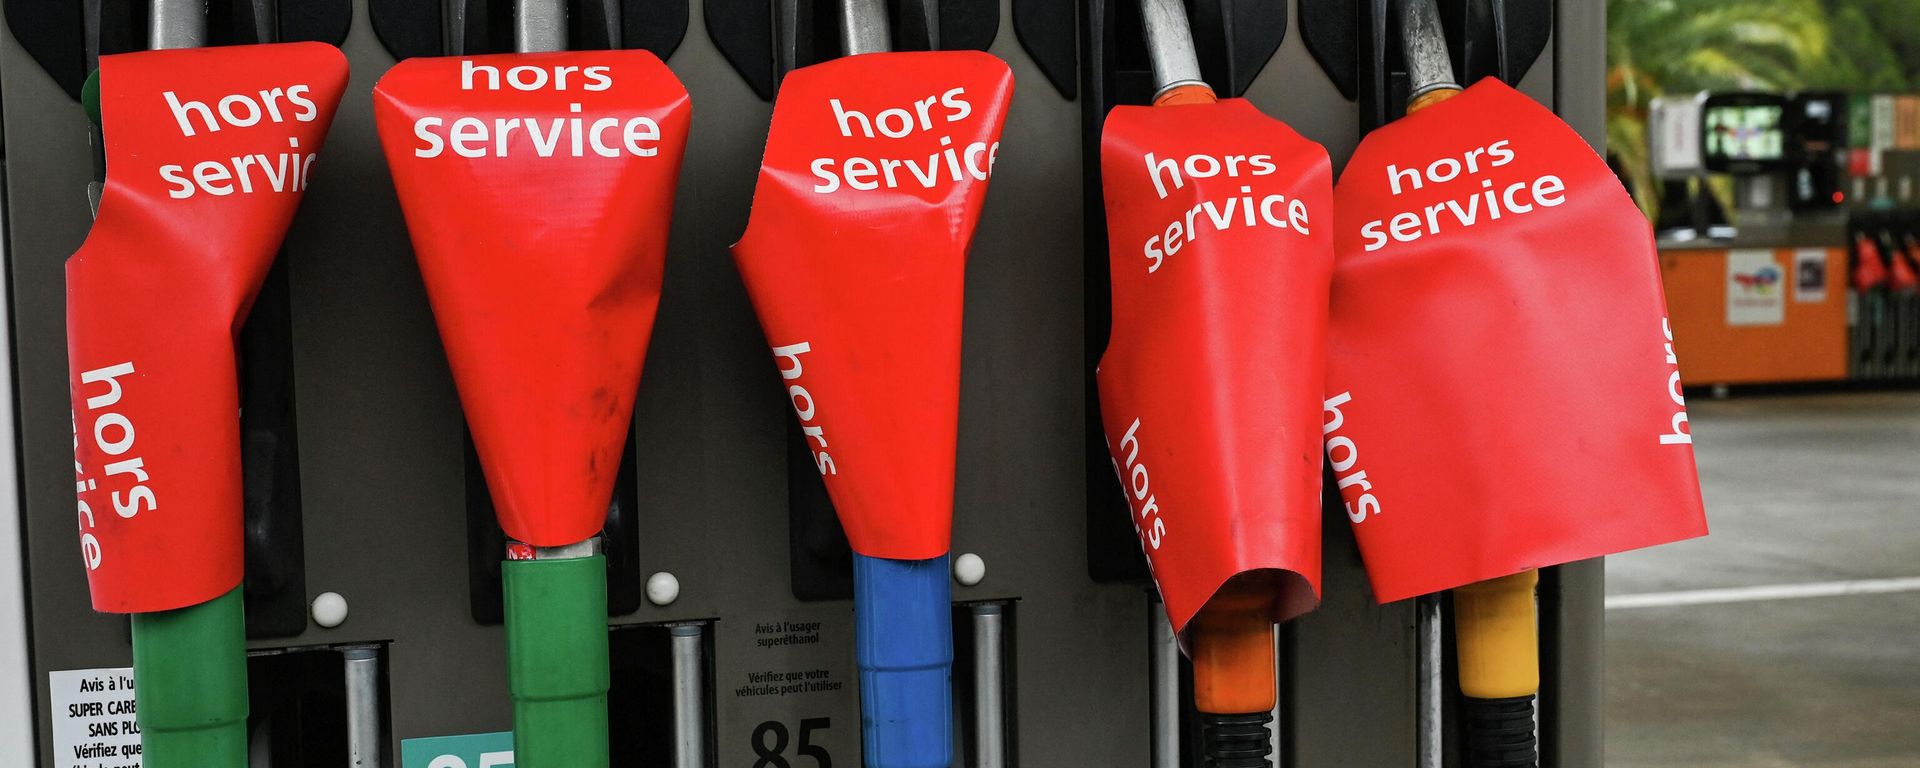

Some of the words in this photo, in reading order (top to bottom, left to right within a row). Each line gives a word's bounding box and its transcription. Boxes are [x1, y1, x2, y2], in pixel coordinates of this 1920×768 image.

[461, 60, 613, 91] hors
[162, 84, 318, 137] hors
[413, 103, 661, 158] service
[829, 87, 972, 139] hors
[1144, 152, 1277, 200] hors
[1386, 139, 1515, 195] hors
[1143, 185, 1310, 274] service
[1360, 174, 1566, 252] service
[772, 341, 837, 476] hors
[80, 361, 158, 519] hors
[1323, 391, 1381, 524] hors
[1119, 417, 1166, 550] hors
[754, 624, 774, 635] Avis
[775, 623, 782, 633] à
[784, 621, 821, 634] l'usager
[757, 632, 820, 648] superéthanol
[80, 677, 105, 693] Avis
[108, 676, 116, 691] à
[735, 684, 780, 697] véhicules
[781, 683, 804, 697] peut
[804, 681, 843, 693] l'utiliser
[748, 671, 784, 684] Vérifiez
[785, 671, 804, 683] que
[804, 669, 830, 680] votre
[68, 702, 104, 718] SUPER
[88, 722, 119, 738] SANS
[73, 742, 117, 760] Vérifiez
[121, 743, 142, 760] que
[751, 717, 832, 768] 85
